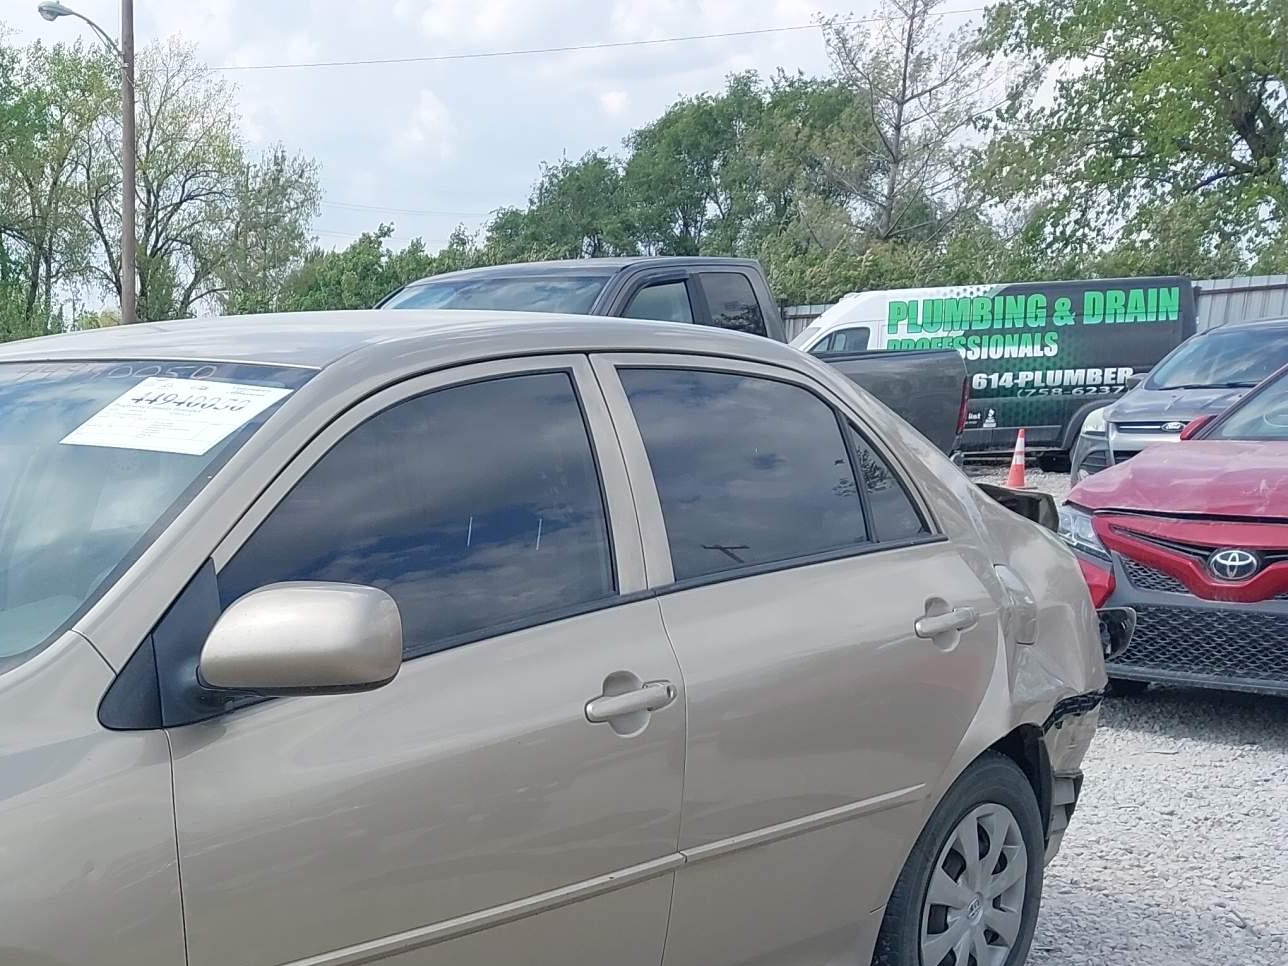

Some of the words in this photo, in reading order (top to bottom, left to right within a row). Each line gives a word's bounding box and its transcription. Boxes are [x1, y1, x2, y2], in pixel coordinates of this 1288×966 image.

[887, 294, 1047, 334] PLUMBING
[1053, 297, 1075, 326] &
[1083, 287, 1180, 325] DRAIN
[972, 367, 1134, 389] 614-PLUMBER
